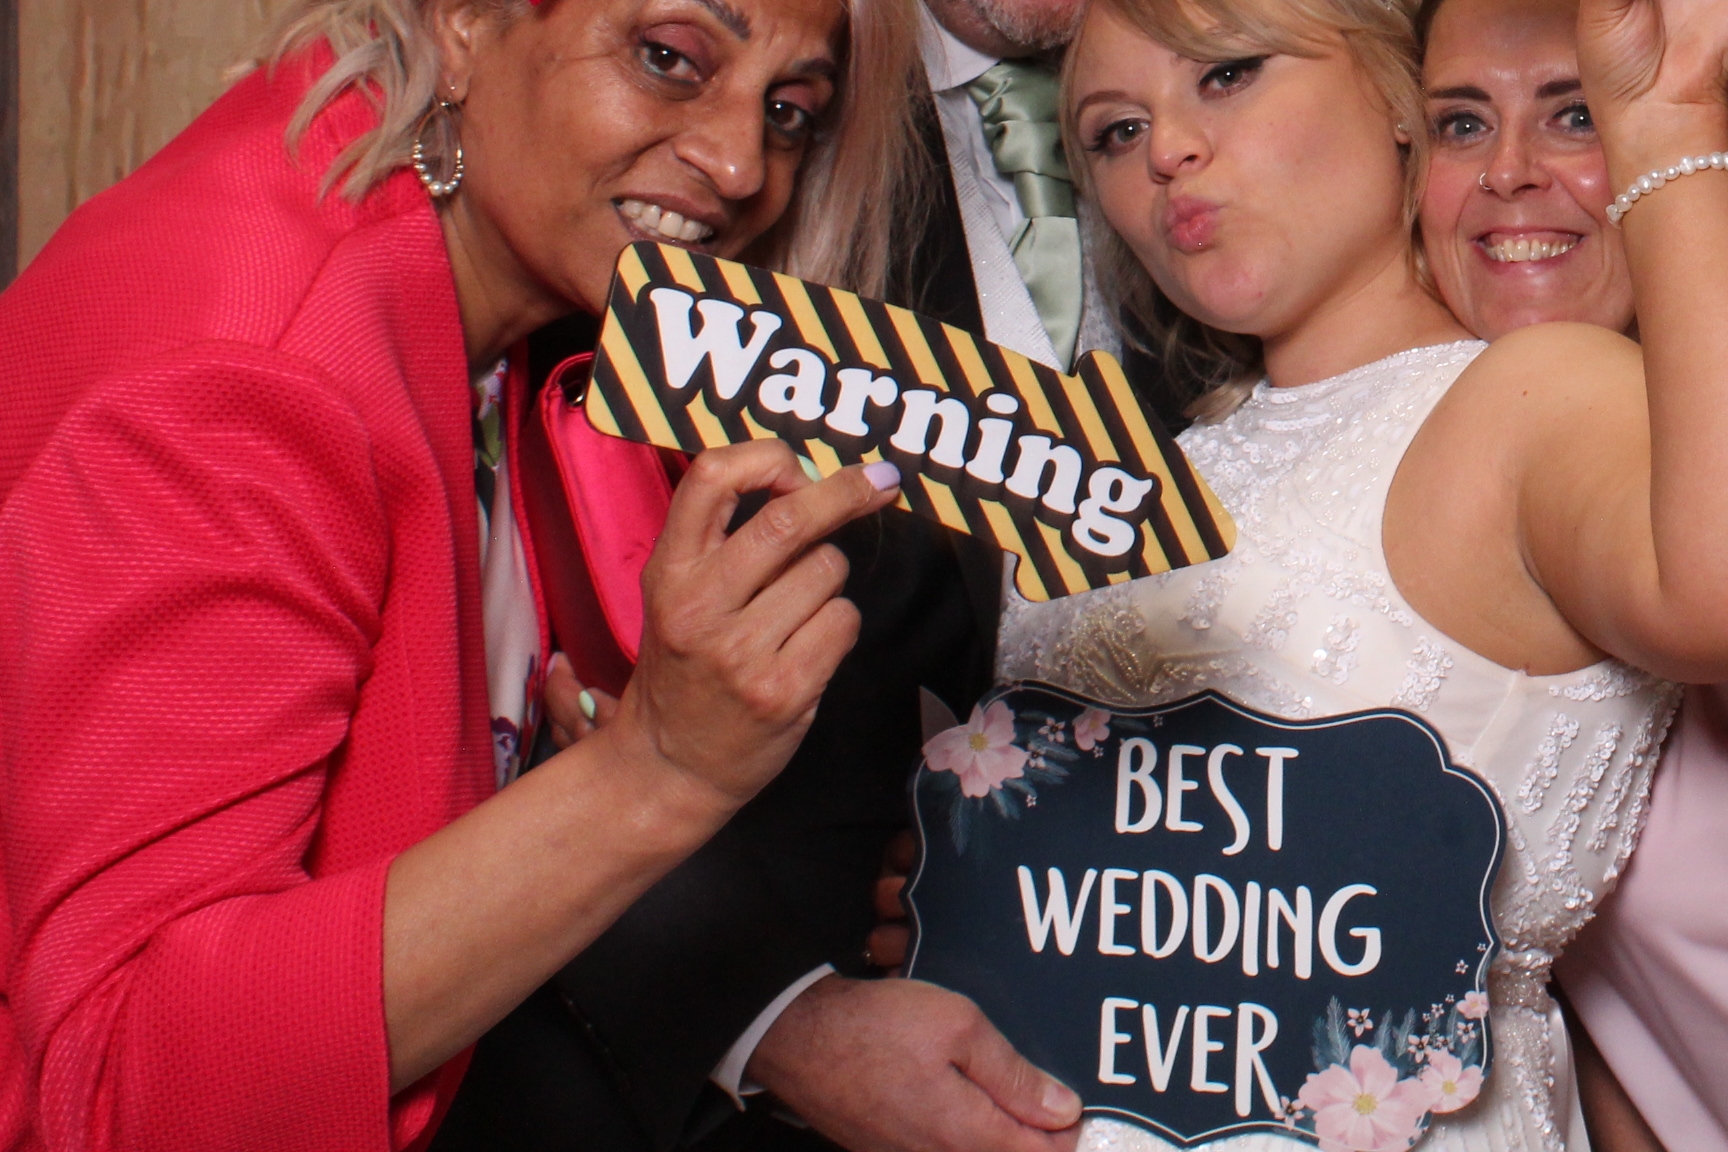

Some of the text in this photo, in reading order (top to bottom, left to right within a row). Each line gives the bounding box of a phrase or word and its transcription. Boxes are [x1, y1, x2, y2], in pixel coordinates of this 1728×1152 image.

[650, 287, 1152, 557] Warning
[1114, 737, 1299, 856] BEST
[1017, 865, 1382, 980] WEDDING
[1098, 997, 1280, 1117] EVER
